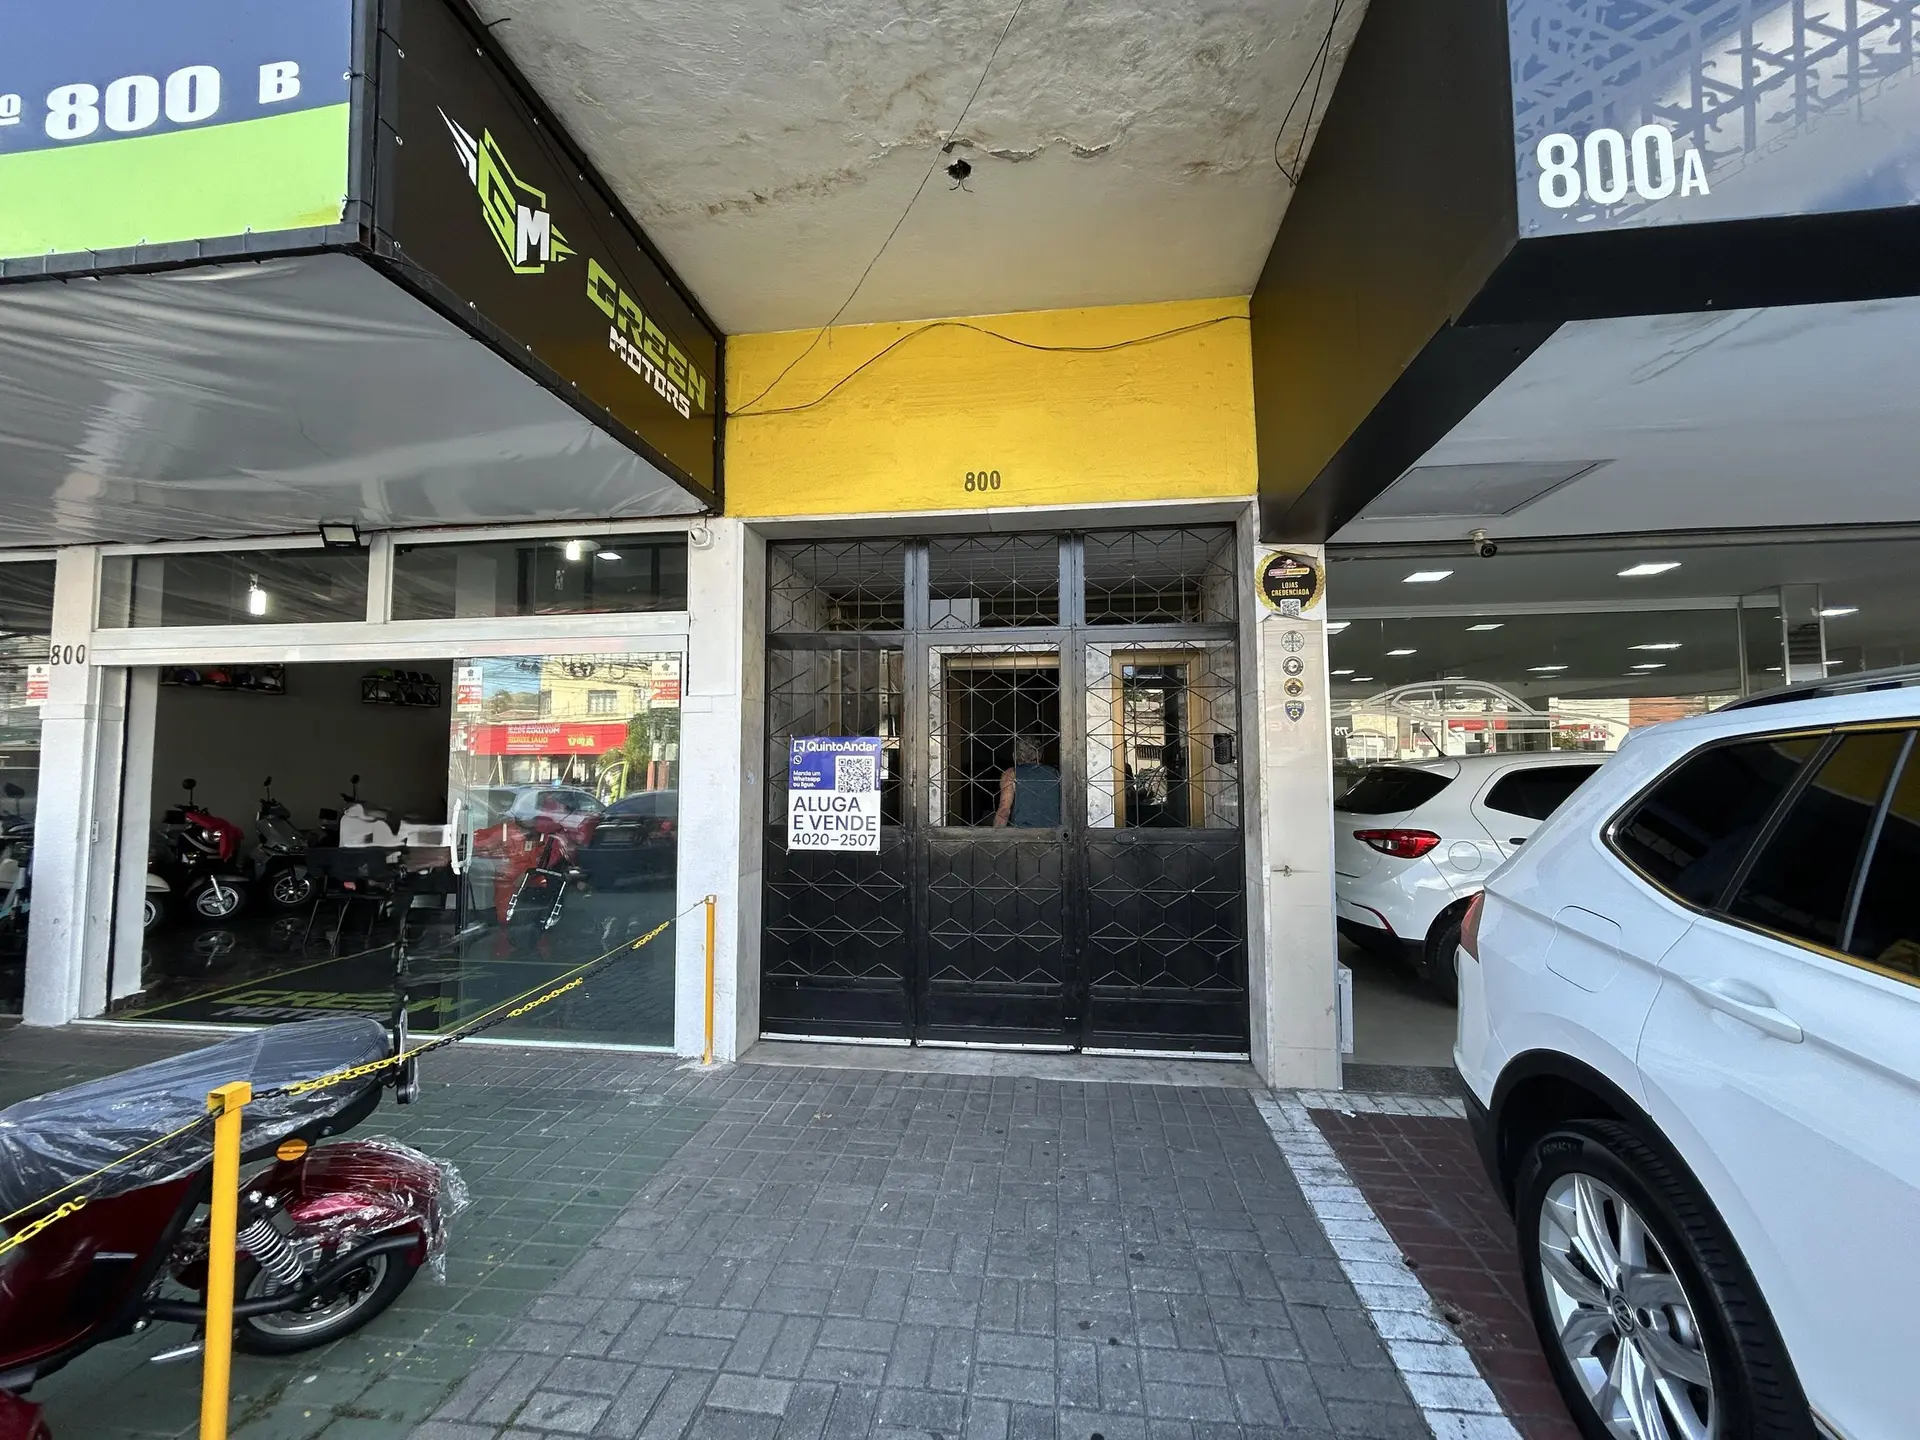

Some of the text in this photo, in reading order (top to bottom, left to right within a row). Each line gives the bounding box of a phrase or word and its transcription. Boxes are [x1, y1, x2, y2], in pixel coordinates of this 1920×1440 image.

[45, 65, 221, 140] 800
[259, 60, 301, 104] B
[586, 257, 706, 411] GREEN
[609, 325, 691, 420] MOTORS
[964, 470, 1001, 492] 800
[1271, 588, 1310, 596] CREDENCIADA
[1281, 581, 1299, 589] LOJAS
[50, 644, 86, 666] 800
[806, 741, 878, 752] QuintoAndar
[793, 796, 861, 812] ALUGA
[794, 815, 877, 831] E VENDE
